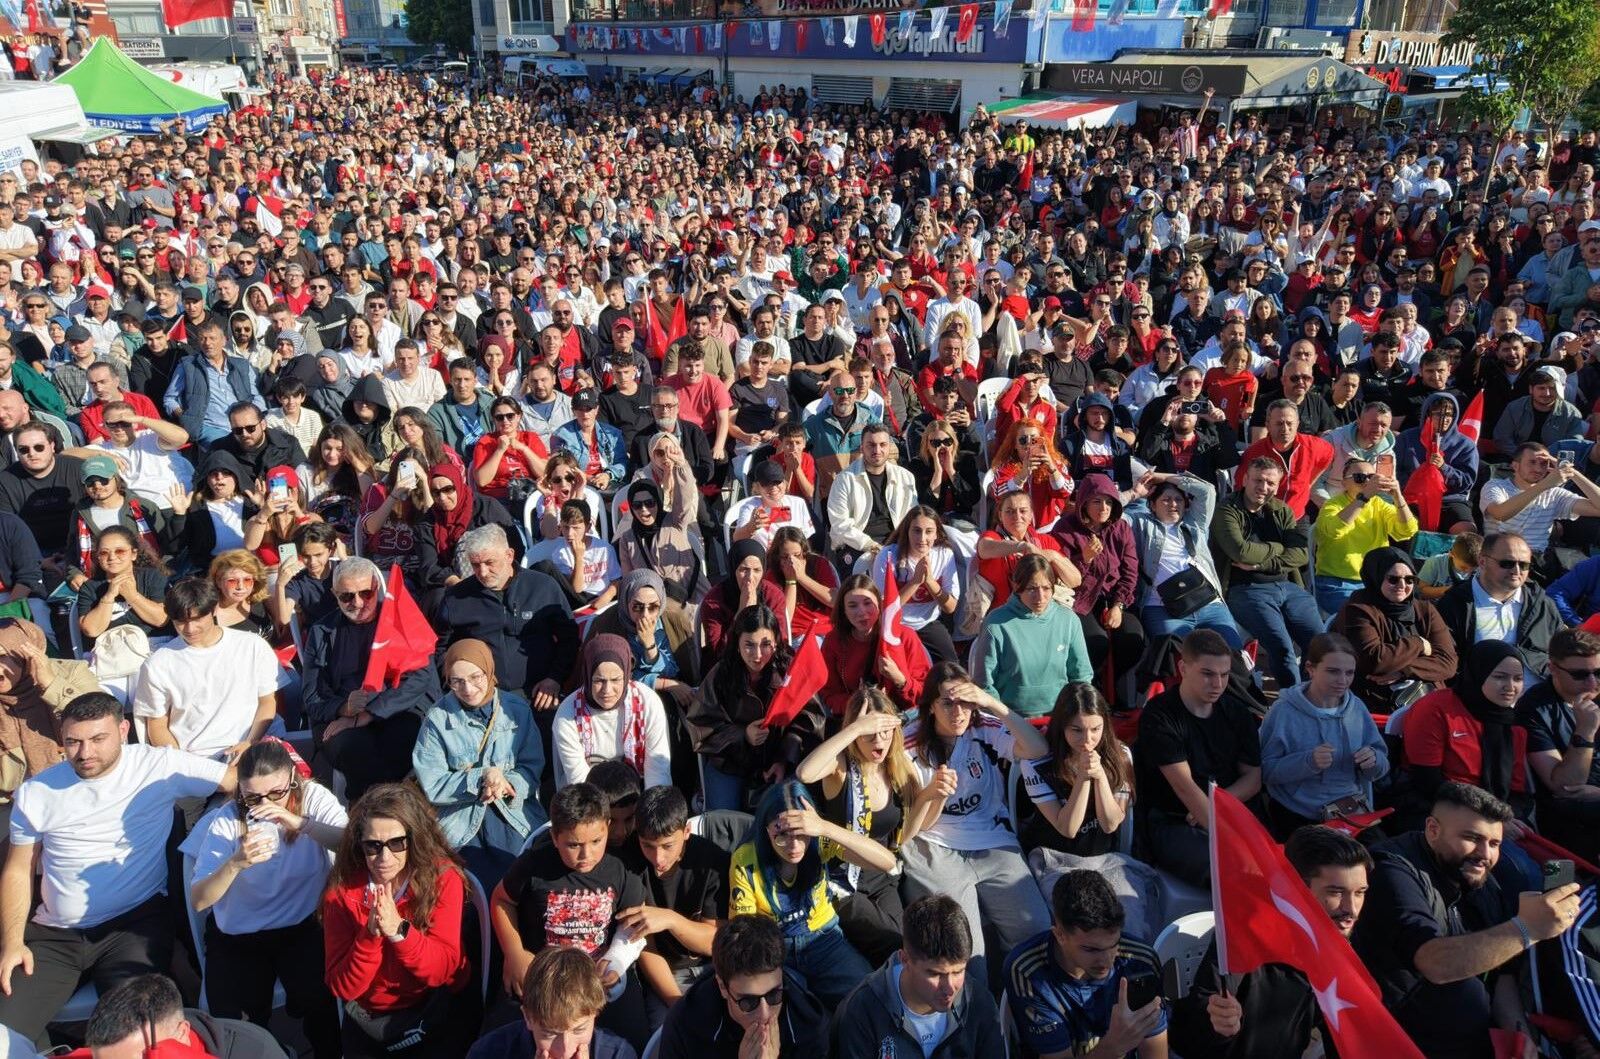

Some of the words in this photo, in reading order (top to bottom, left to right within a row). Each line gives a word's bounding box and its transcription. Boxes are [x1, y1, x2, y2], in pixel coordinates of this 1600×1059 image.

[515, 38, 538, 49] QNB
[1072, 68, 1105, 84] VERA
[87, 118, 143, 130] ELEDİYESİ
[947, 793, 982, 813] eko
